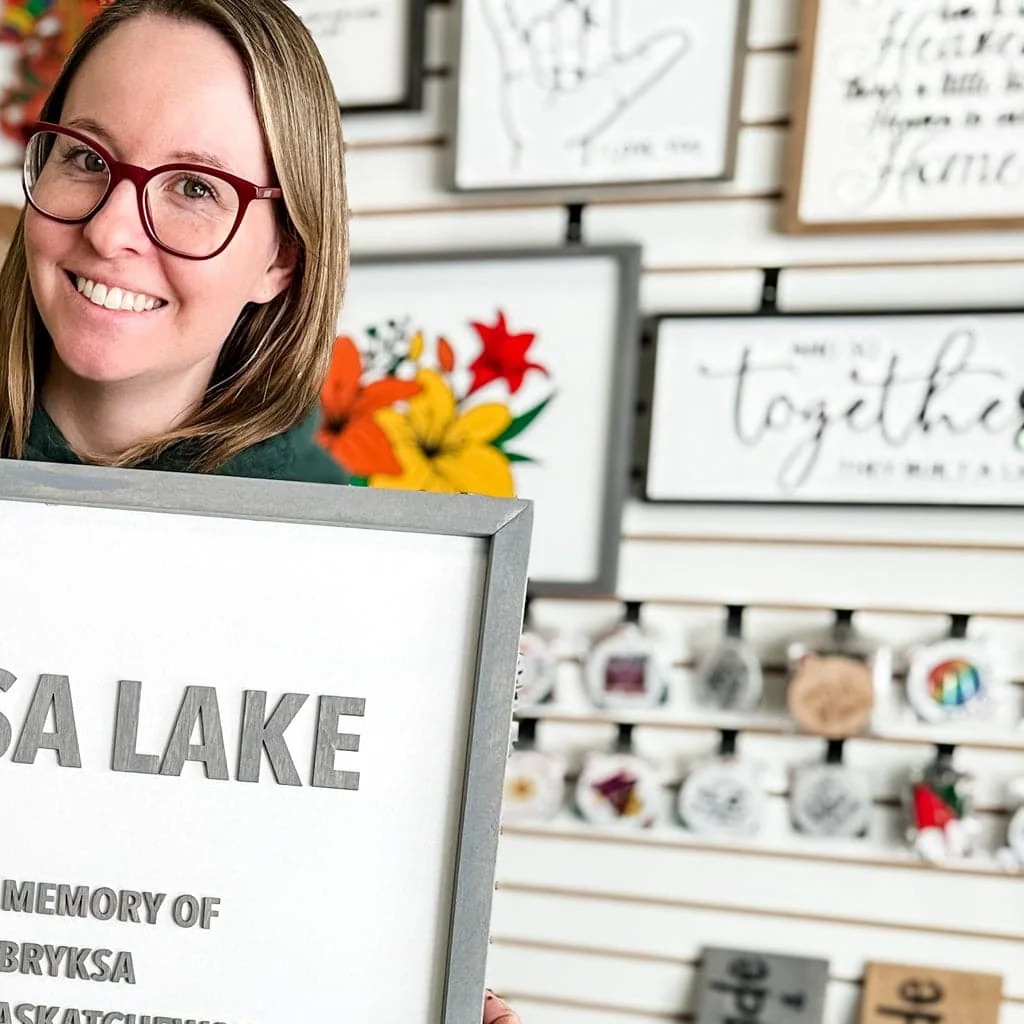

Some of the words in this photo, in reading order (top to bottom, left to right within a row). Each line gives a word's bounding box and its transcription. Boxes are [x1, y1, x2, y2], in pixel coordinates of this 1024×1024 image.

[111, 679, 367, 792] LAKE
[0, 880, 166, 926] MEMORY
[172, 895, 221, 930] OF
